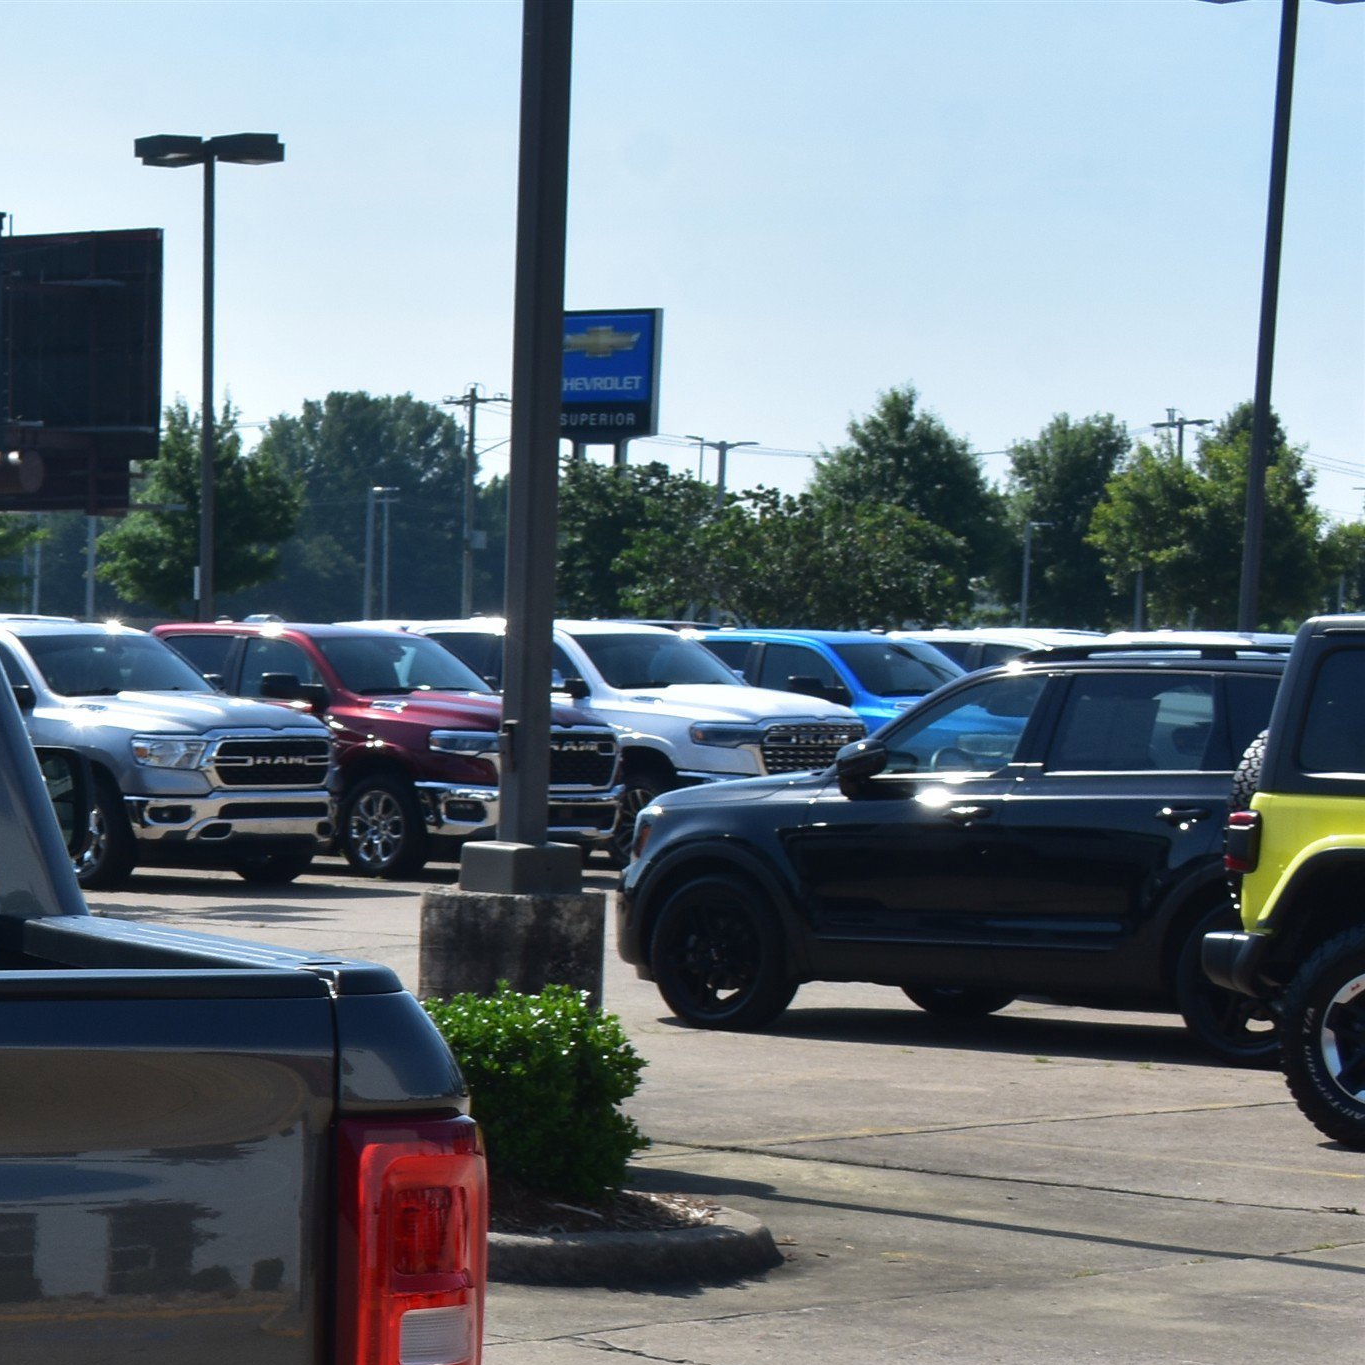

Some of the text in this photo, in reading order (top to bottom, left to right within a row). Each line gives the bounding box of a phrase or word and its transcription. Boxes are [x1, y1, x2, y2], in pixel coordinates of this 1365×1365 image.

[562, 375, 643, 391] HEVROLET
[559, 412, 637, 426] SUPERIOR
[255, 755, 304, 765] RAM
